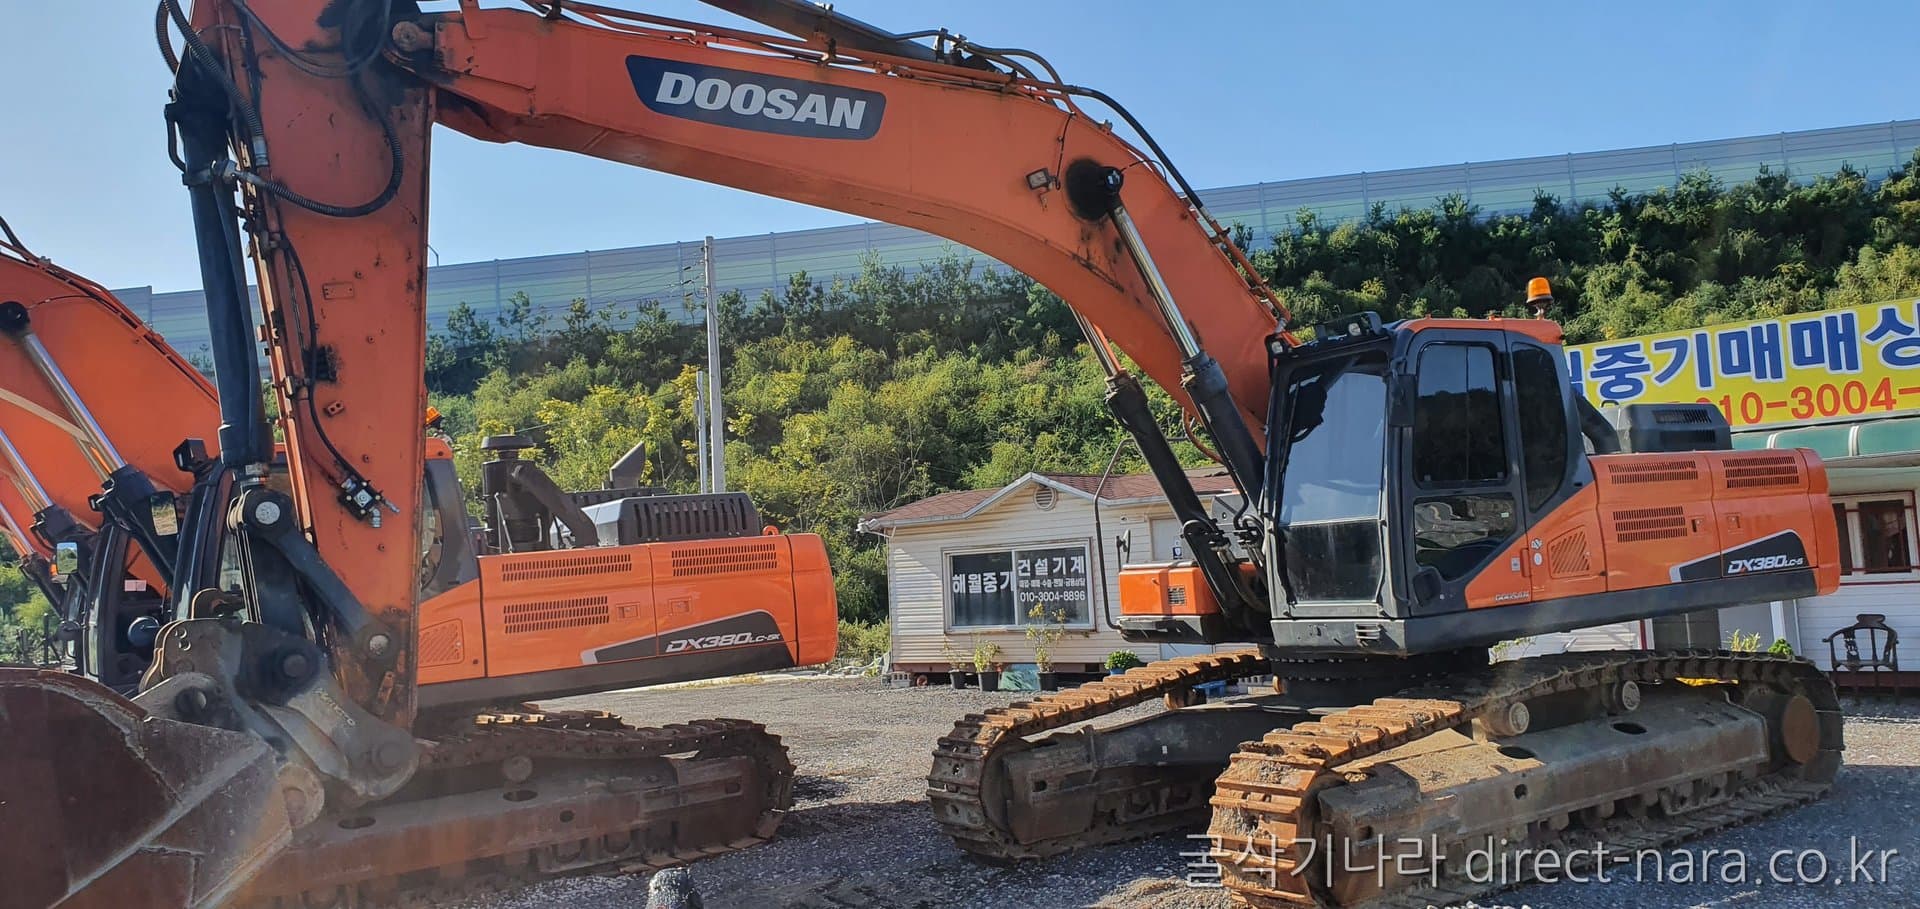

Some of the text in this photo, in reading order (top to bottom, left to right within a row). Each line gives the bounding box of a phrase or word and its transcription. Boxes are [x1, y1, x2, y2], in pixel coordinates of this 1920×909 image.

[656, 71, 866, 130] DOOSAN
[1696, 377, 1920, 426] 10-3004-
[952, 571, 1016, 594] 해월중기
[1020, 591, 1086, 602] 010-3004-8896
